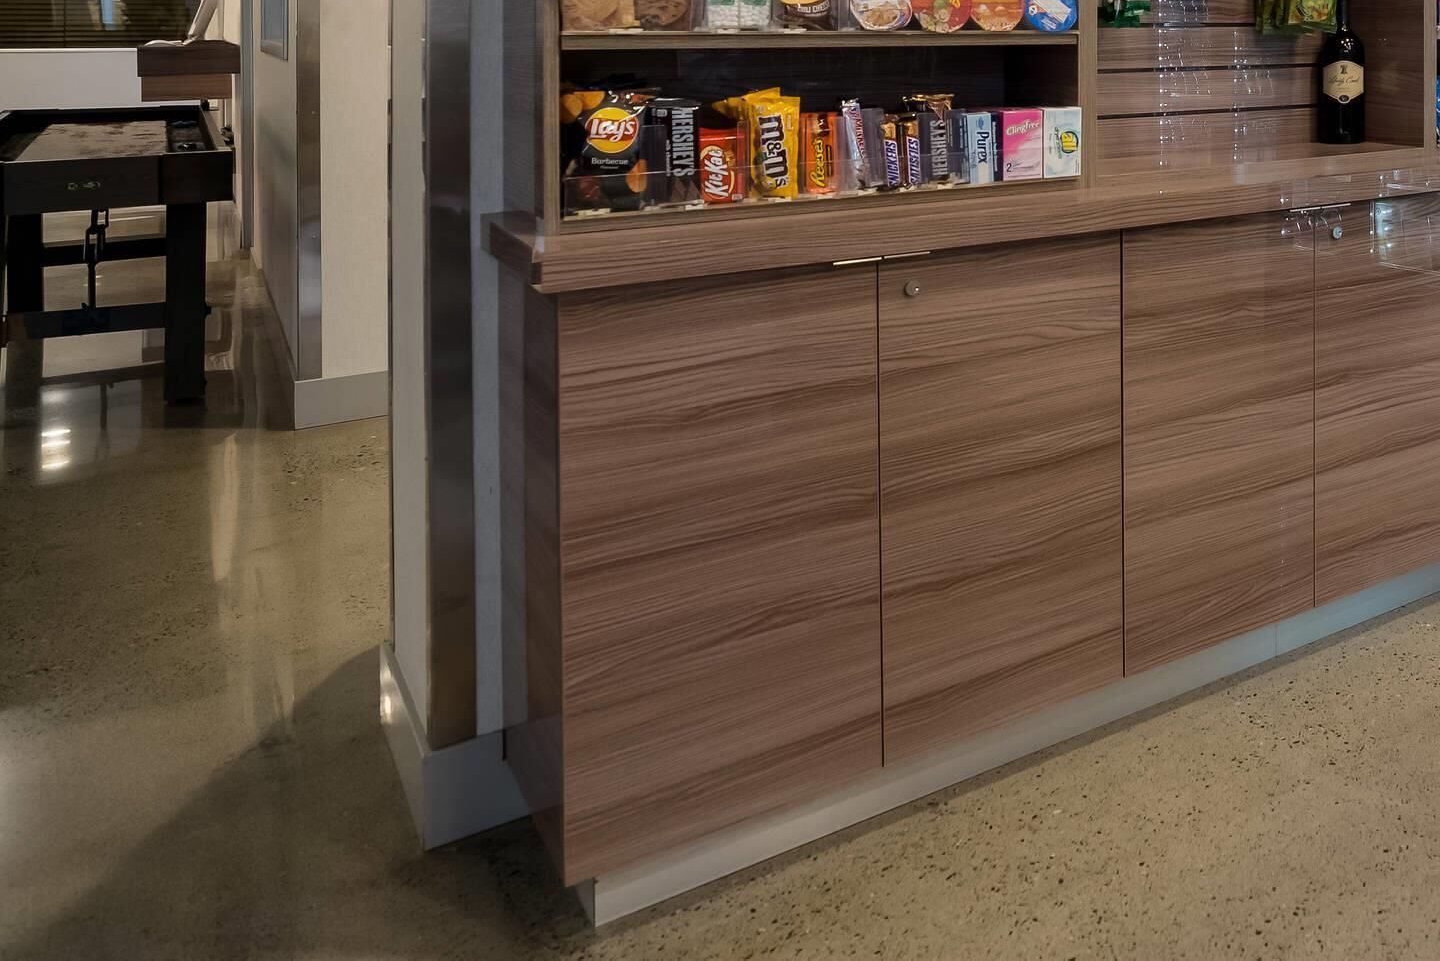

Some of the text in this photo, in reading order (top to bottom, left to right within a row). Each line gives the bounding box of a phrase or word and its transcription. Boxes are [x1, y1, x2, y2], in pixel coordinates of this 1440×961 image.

[590, 117, 636, 143] Lay's
[672, 106, 695, 177] HERSHEY'S
[591, 157, 629, 166] Barbecue
[885, 140, 900, 187] SNICKERS
[930, 119, 948, 177] HERSHEY'S
[976, 131, 990, 164] Purex
[1006, 163, 1012, 173] 2
